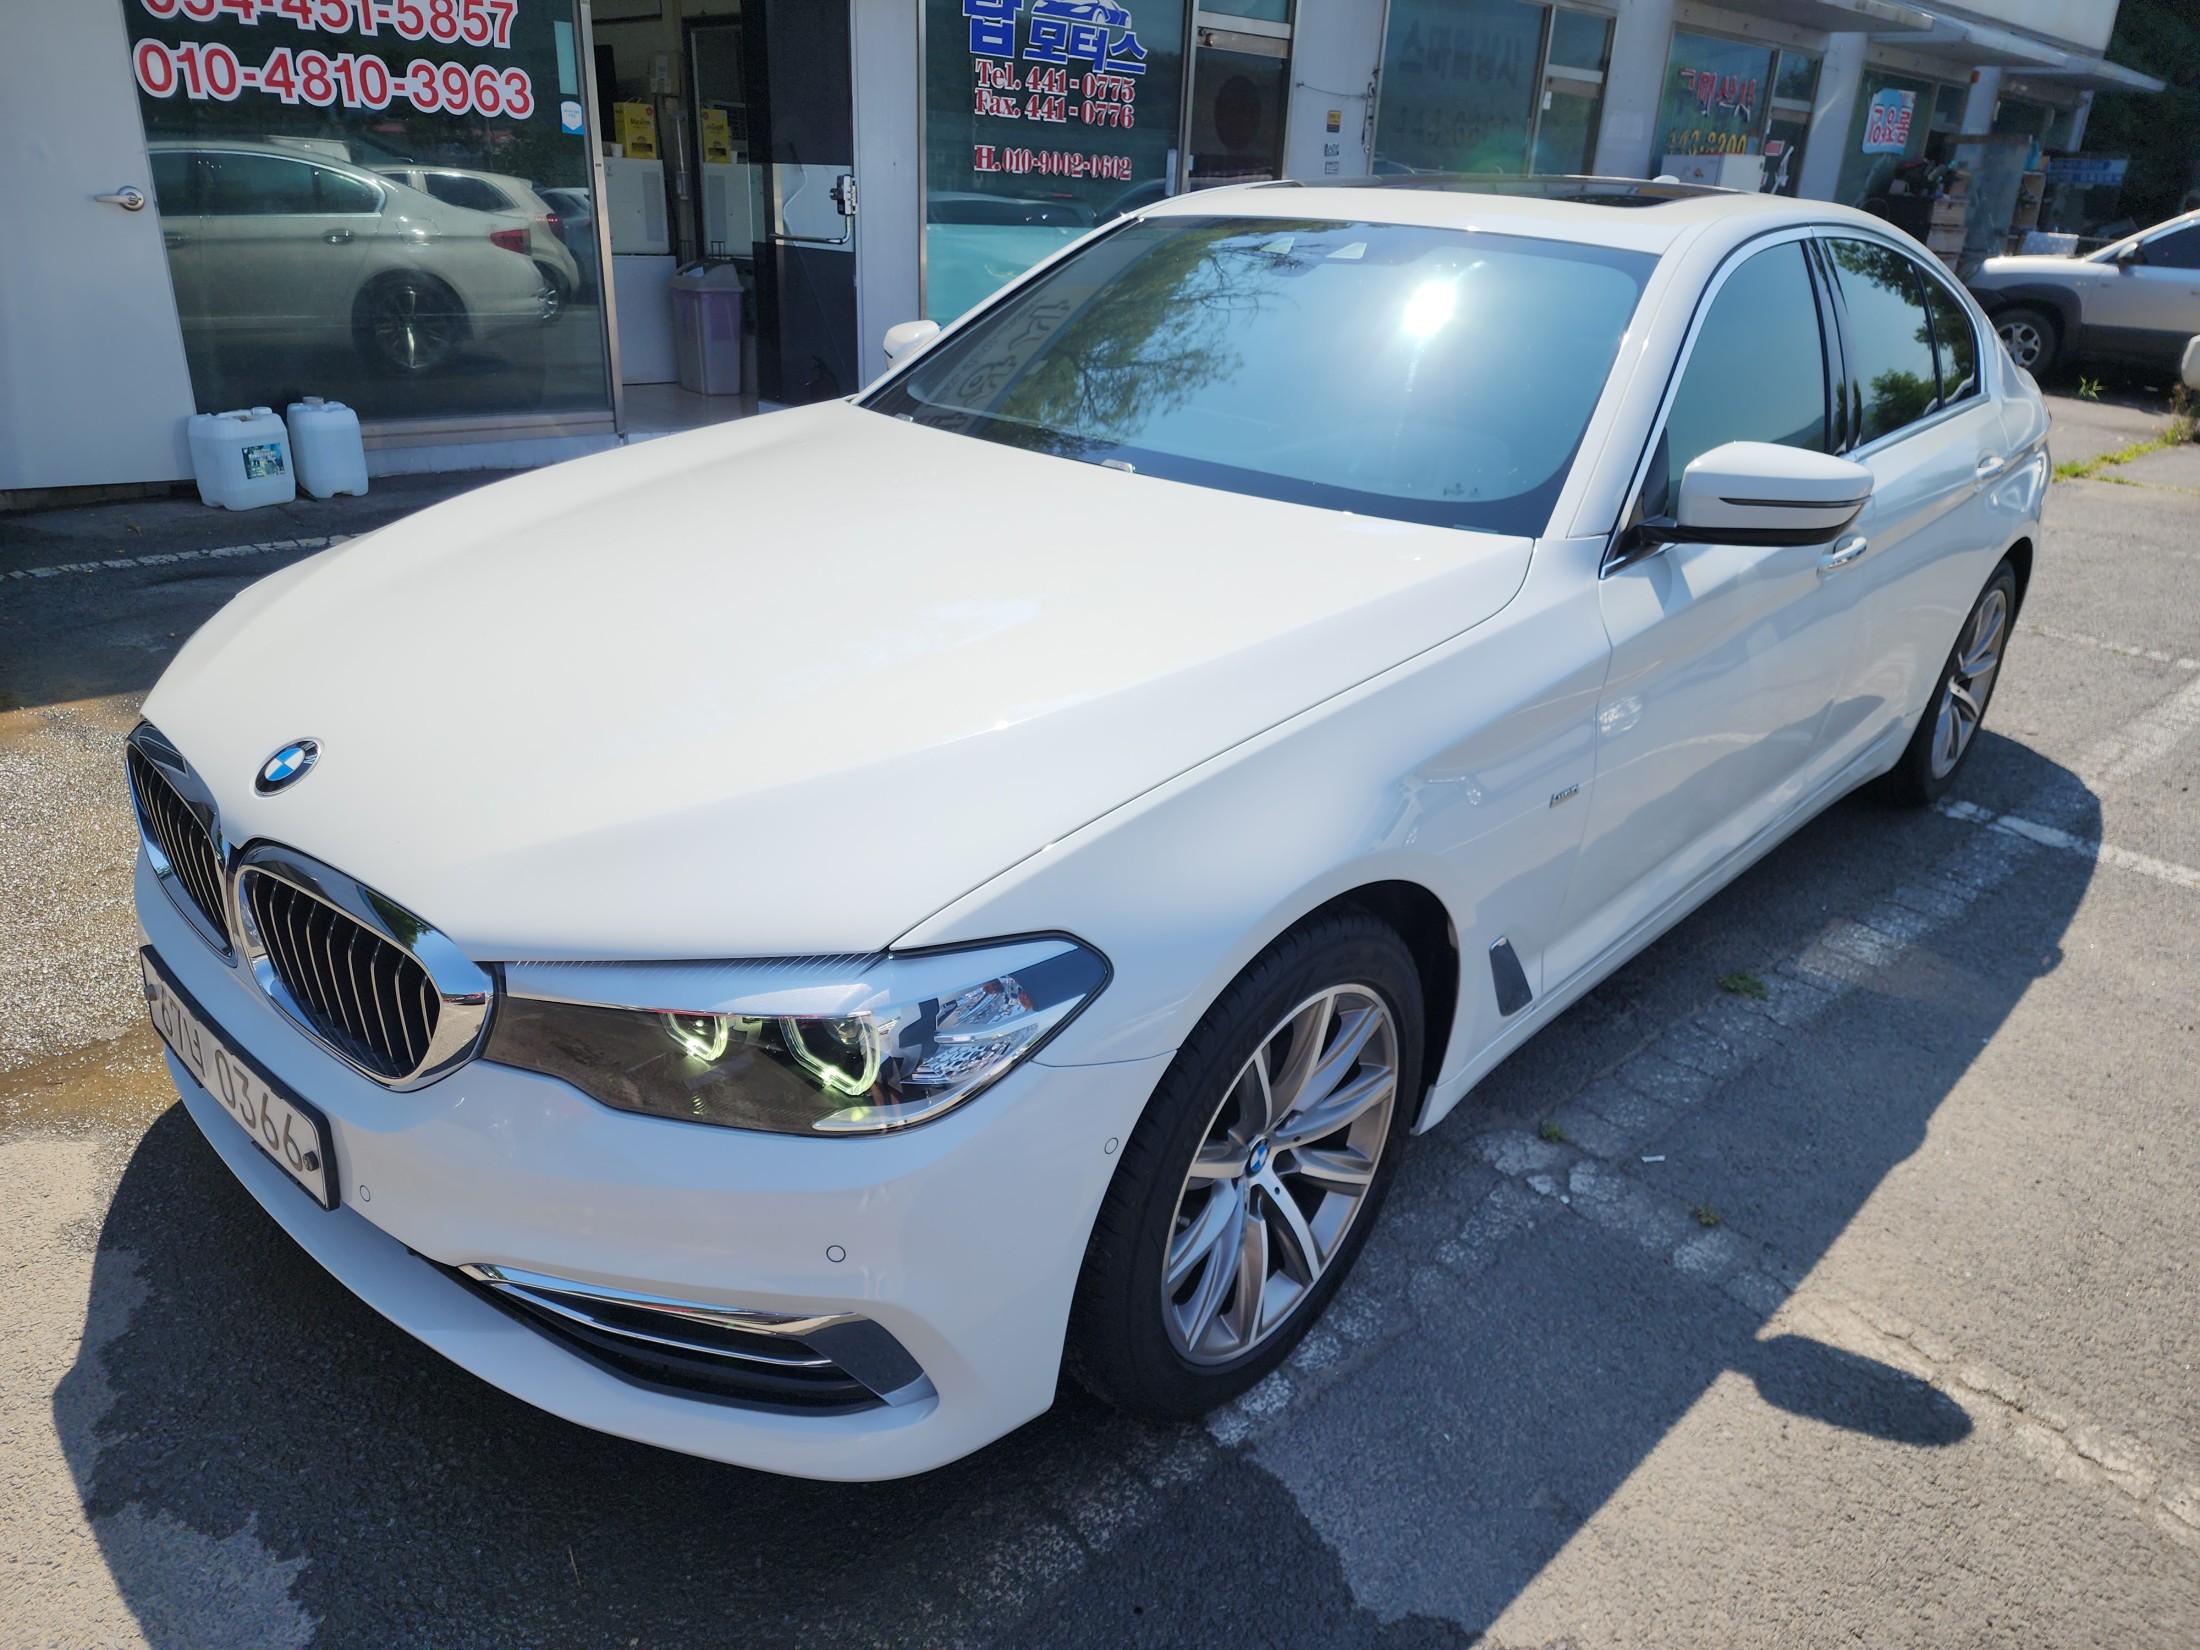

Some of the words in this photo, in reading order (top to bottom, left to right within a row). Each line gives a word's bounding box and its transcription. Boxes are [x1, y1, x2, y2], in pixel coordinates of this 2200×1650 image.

[975, 59, 1021, 89] Tel.
[1022, 17, 1148, 74] 모터스
[133, 38, 535, 119] 010-4810-3963
[975, 88, 1021, 119] Fax.
[214, 1049, 304, 1173] 0366
